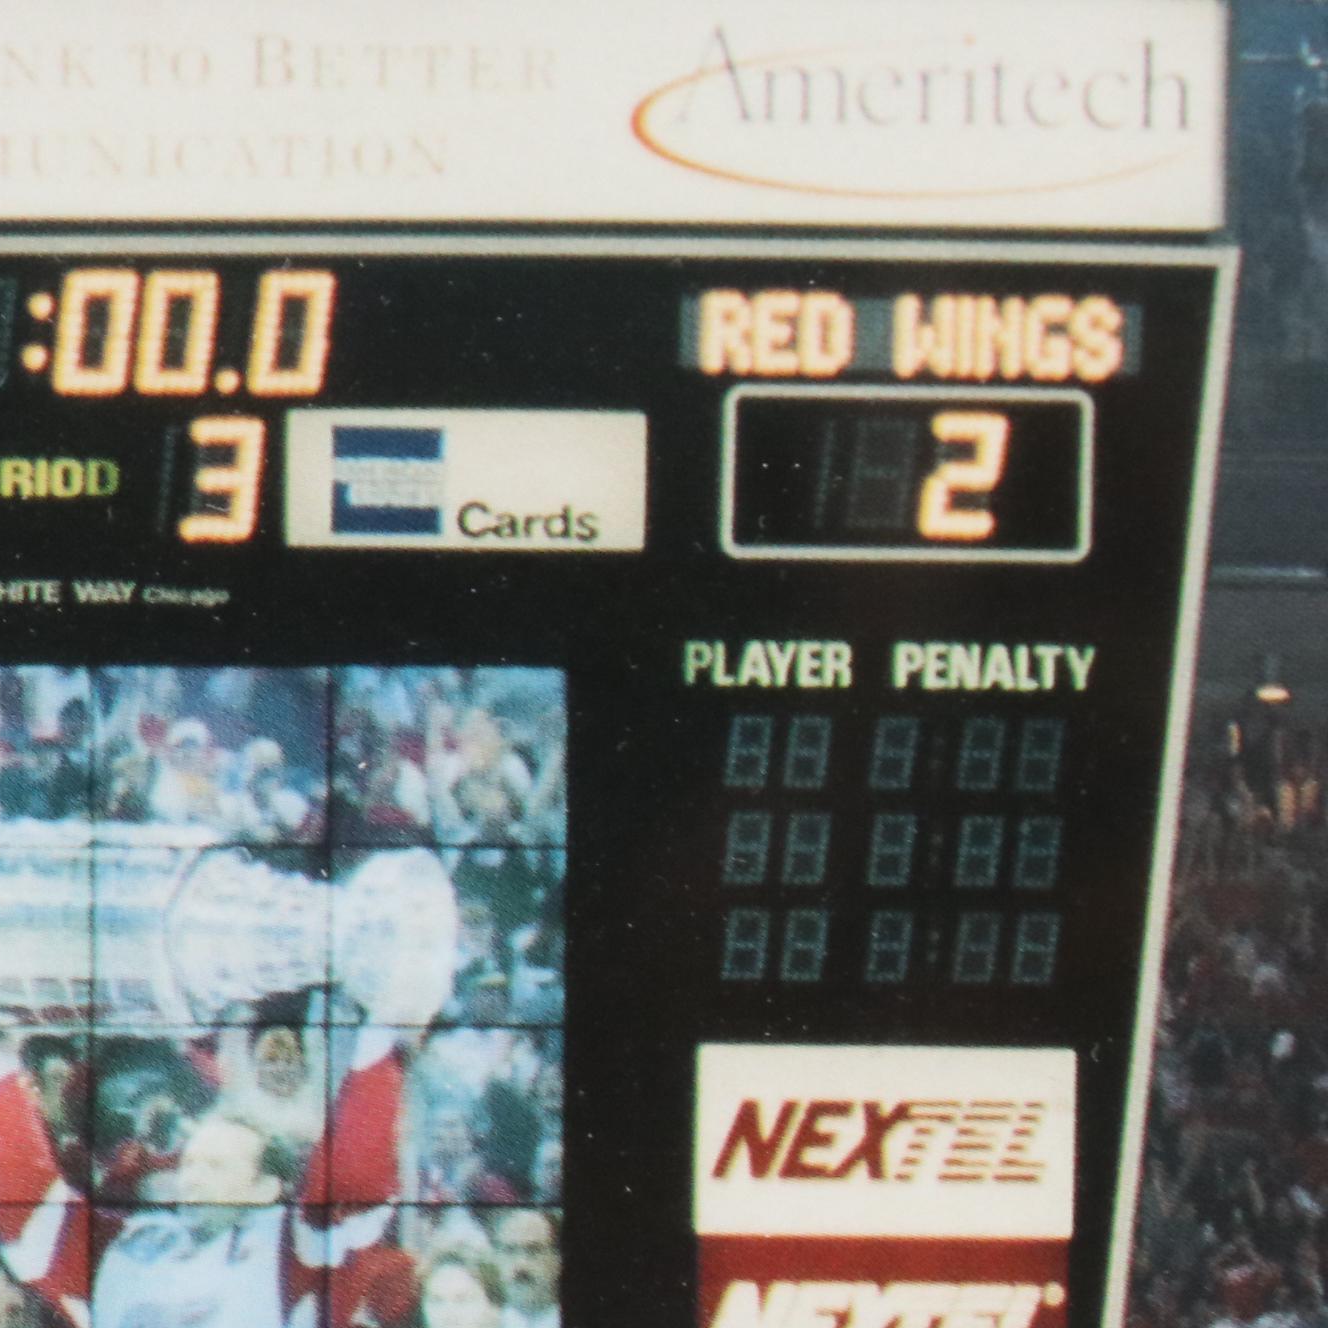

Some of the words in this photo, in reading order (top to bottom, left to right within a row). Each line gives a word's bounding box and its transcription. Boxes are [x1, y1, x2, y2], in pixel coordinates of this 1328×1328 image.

[675, 24, 1190, 131] Ameritech
[697, 290, 856, 376] RED
[892, 294, 1125, 382] WINGS
[178, 416, 266, 544] 3
[918, 411, 1010, 541] 2
[456, 501, 600, 542] Cards
[71, 579, 137, 604] WAY
[683, 640, 853, 688] PLAYER
[891, 641, 1095, 690] PENALTY
[710, 1098, 1047, 1180] NEXTEL
